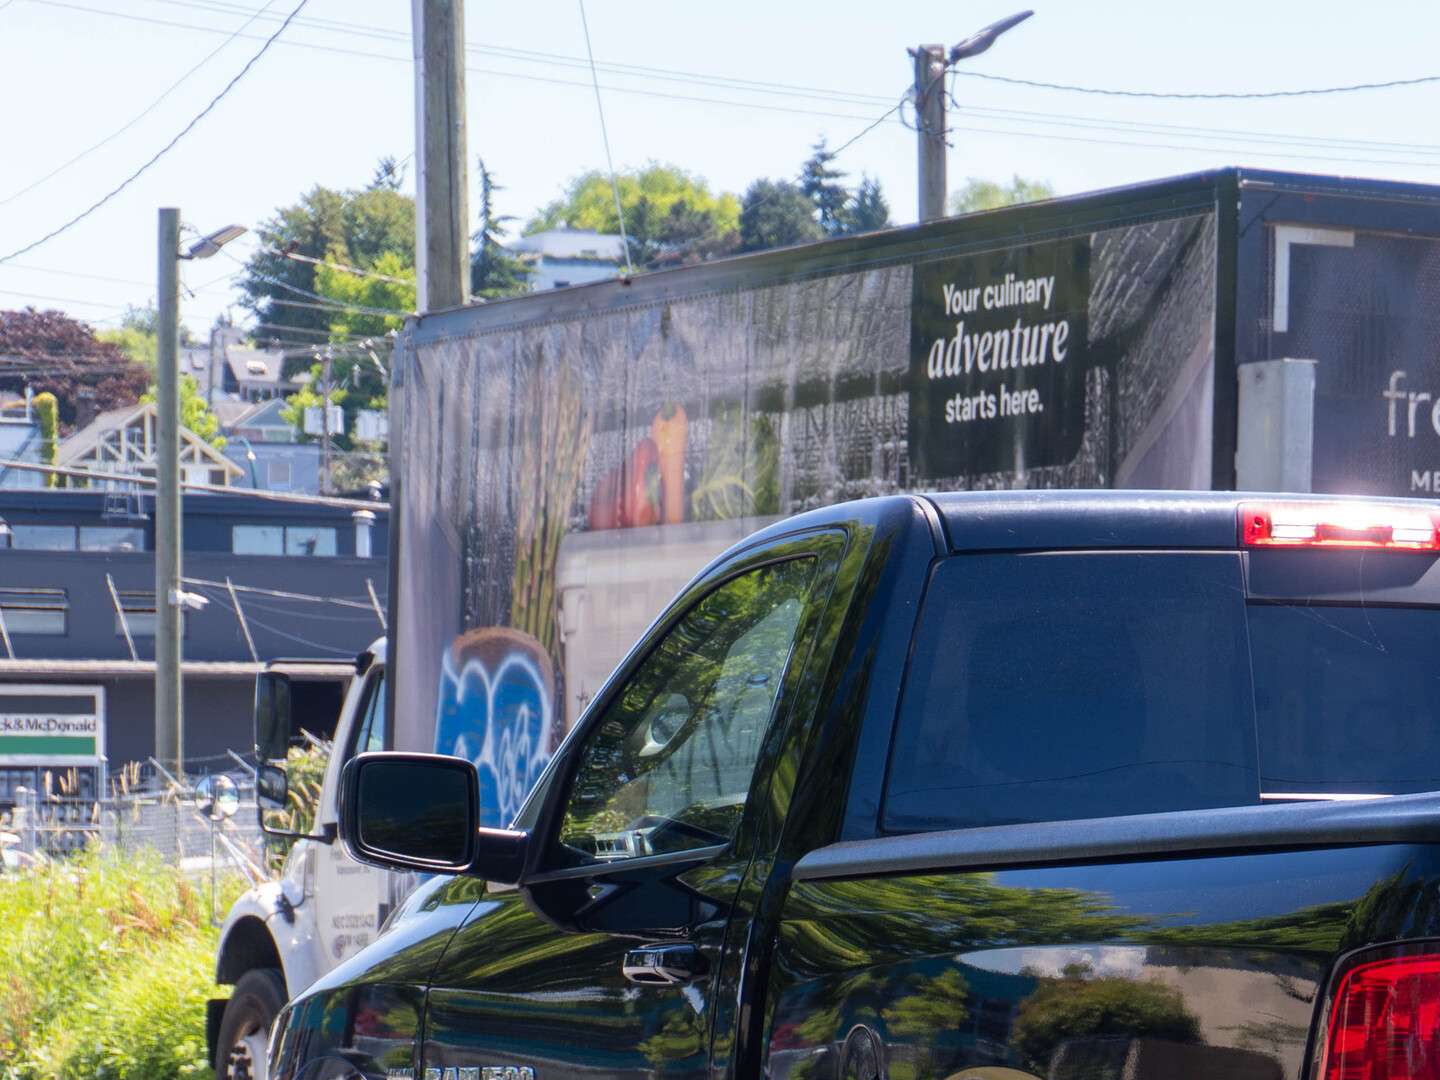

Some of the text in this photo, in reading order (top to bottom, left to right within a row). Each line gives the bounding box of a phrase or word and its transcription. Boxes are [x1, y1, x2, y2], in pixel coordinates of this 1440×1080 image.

[942, 273, 1055, 316] Your culinary
[927, 318, 1069, 380] adventure
[945, 383, 1044, 424] starts here.
